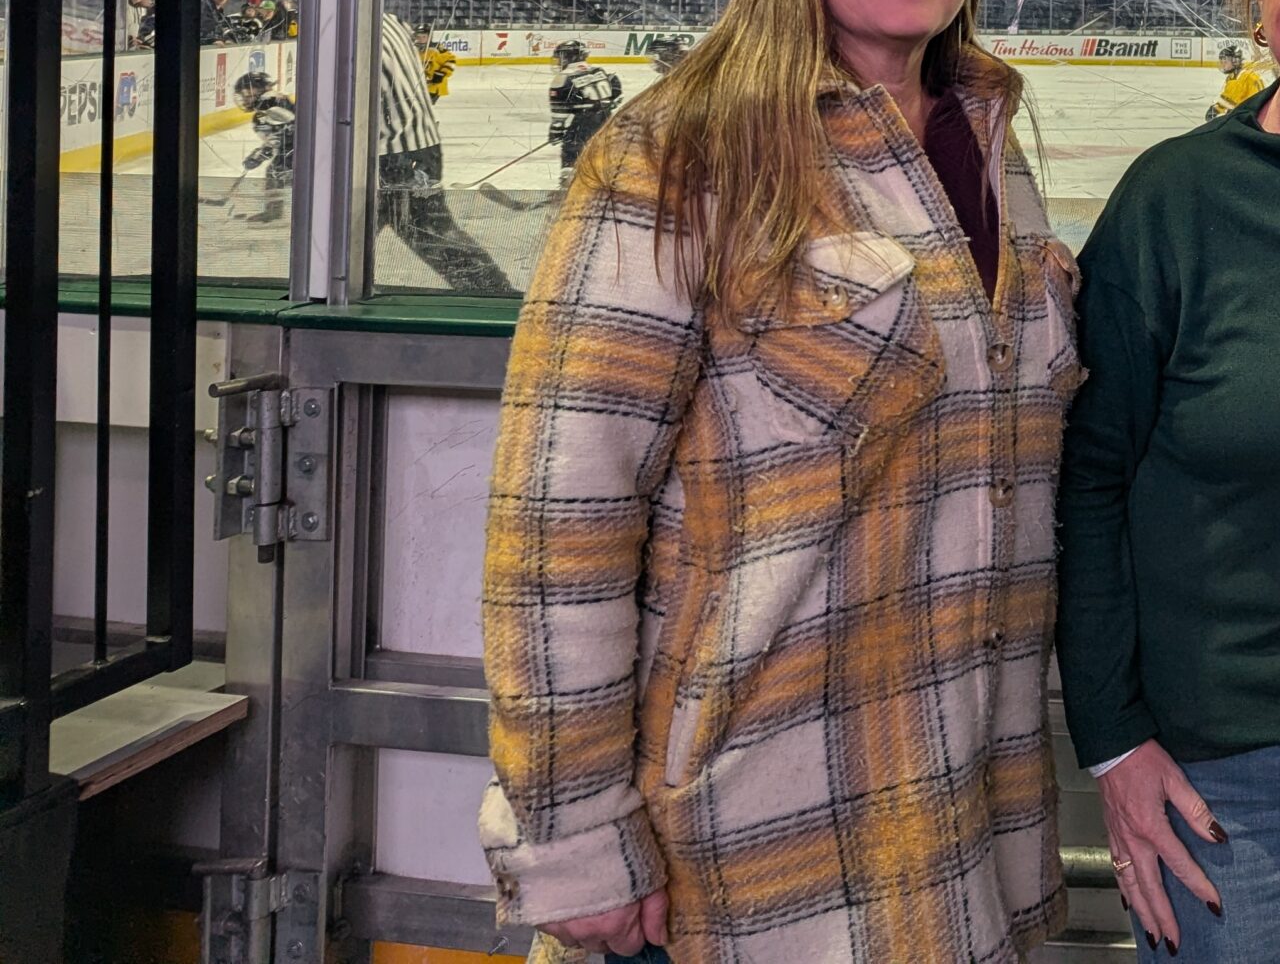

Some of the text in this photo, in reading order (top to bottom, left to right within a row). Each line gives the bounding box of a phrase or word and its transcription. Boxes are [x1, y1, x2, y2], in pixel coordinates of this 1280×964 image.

[991, 38, 1074, 57] Tim Hortons
[1094, 38, 1159, 57] Brandt
